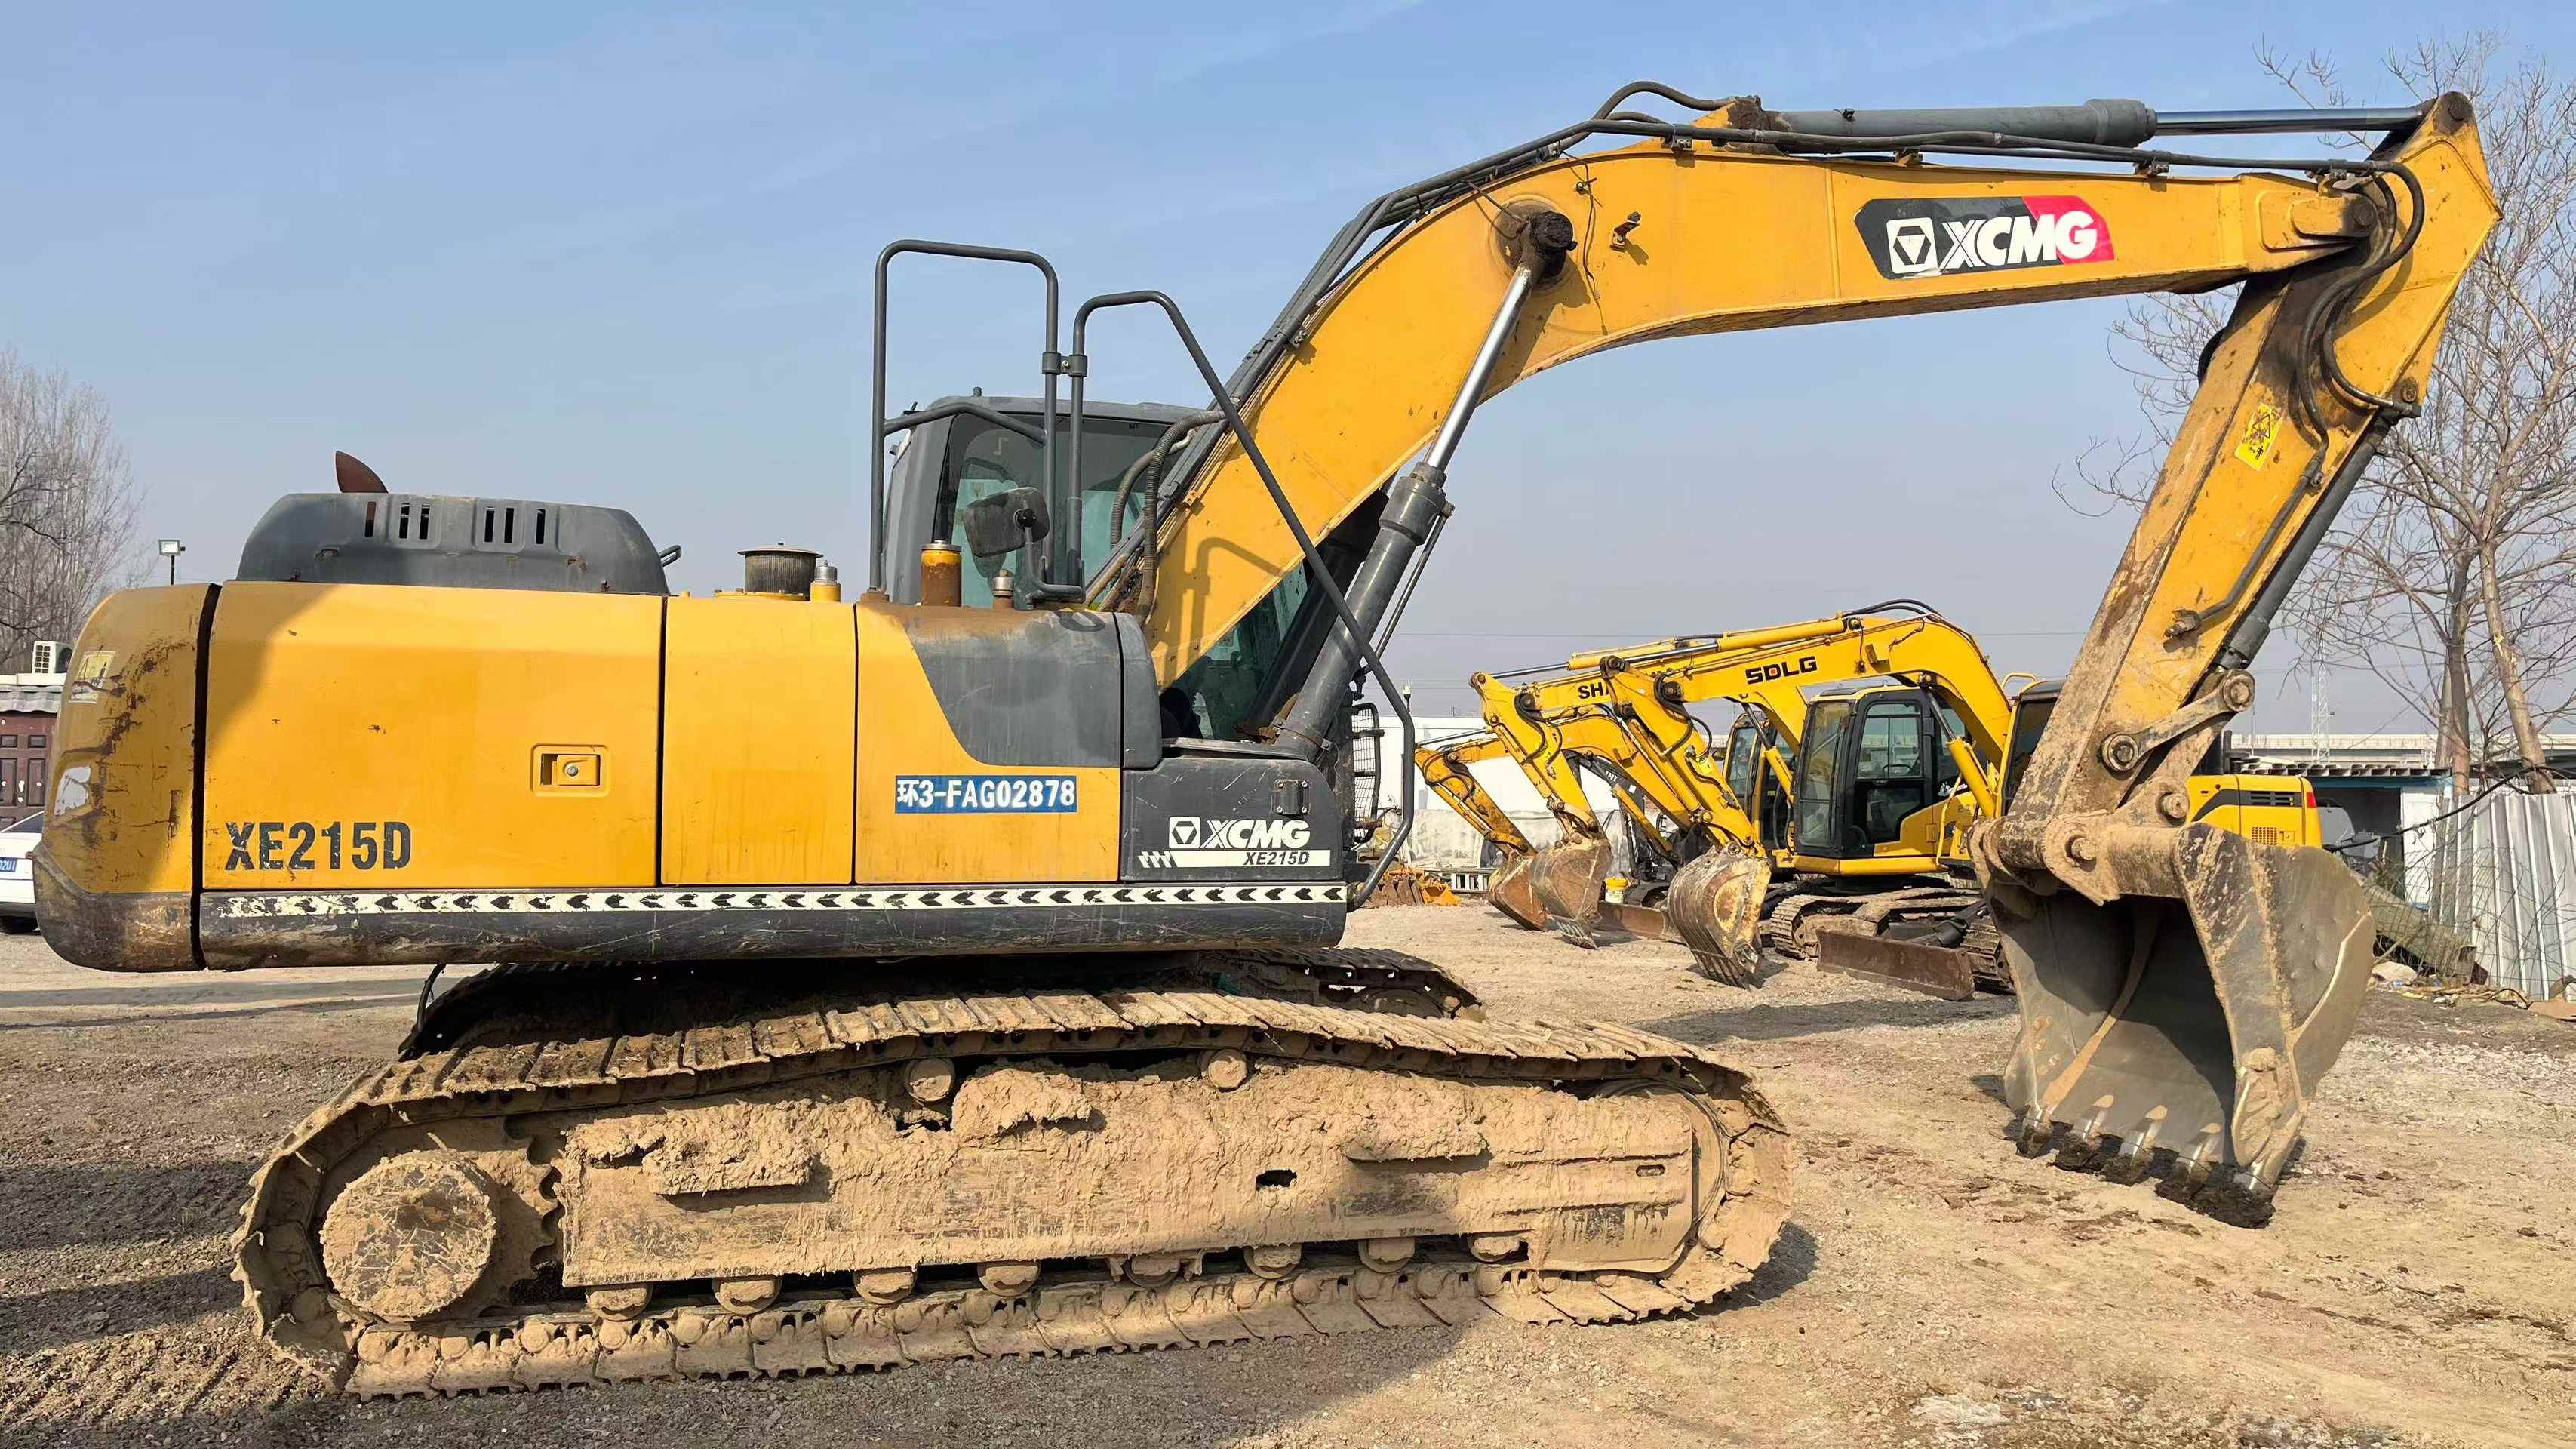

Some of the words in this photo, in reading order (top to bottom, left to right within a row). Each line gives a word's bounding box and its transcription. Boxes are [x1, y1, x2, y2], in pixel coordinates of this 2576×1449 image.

[1938, 211, 2098, 269] XCMG
[1745, 656, 1818, 685] SDLG
[1578, 682, 1609, 699] SH
[224, 821, 411, 870] XE215D
[1200, 820, 1311, 848] XCMG
[1243, 851, 1309, 866] XE215D
